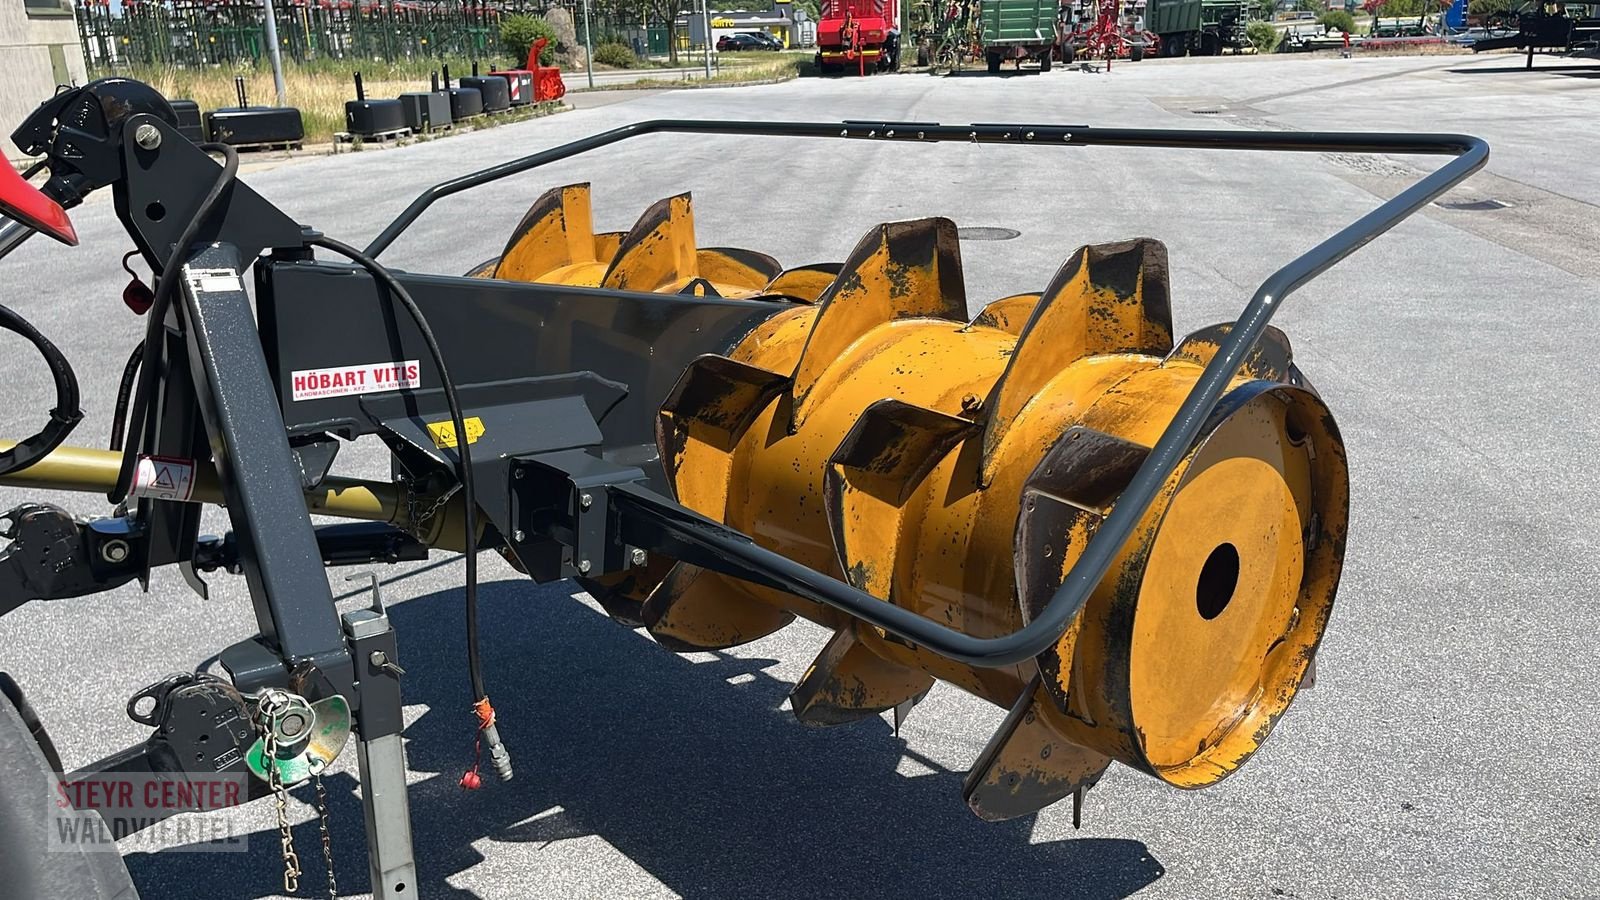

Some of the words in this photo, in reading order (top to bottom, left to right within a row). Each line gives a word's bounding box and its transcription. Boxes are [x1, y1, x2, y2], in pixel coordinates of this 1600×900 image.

[295, 371, 366, 391] HÖBART
[374, 366, 418, 383] VITIS
[296, 388, 349, 398] LANDMASCHINEN
